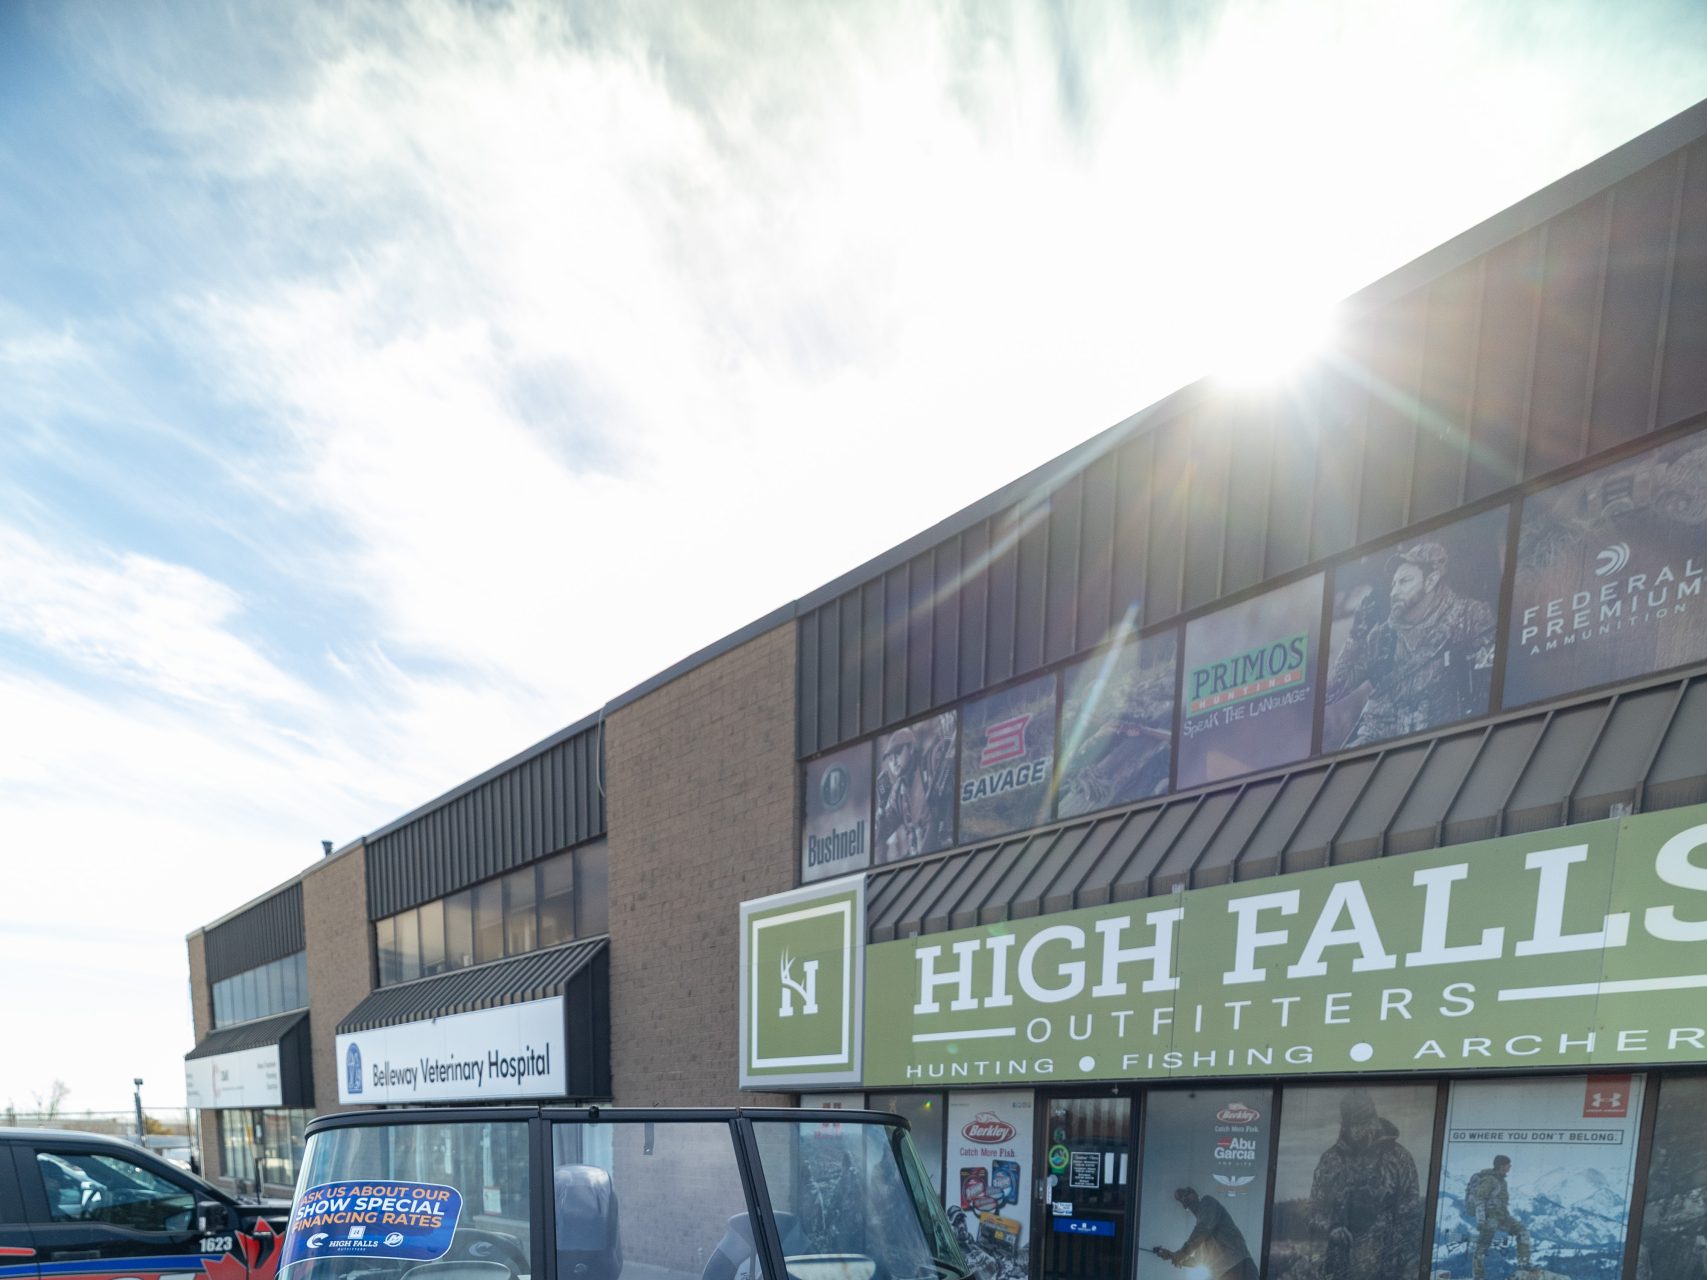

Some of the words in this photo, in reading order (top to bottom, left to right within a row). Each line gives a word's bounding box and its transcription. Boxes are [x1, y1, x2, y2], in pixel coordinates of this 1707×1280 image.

[1523, 559, 1703, 626] FEDERAL
[1521, 577, 1702, 645] PREMIUM
[1530, 603, 1687, 656] AMMUNITION
[1191, 637, 1304, 700] PRIMOS
[1200, 673, 1292, 709] HUNTING
[1222, 705, 1246, 725] THE
[961, 757, 1053, 803] SAVAGE
[808, 820, 865, 868] Bushnell
[914, 907, 1185, 1015] HIGH
[1222, 823, 1707, 985] FALLS
[1026, 982, 1477, 1043] OUTFITTERS
[373, 1063, 418, 1091] Belleway
[420, 1053, 484, 1088] Veterinary
[488, 1042, 550, 1085] Hospital
[906, 1058, 1054, 1078] HUNTING
[1122, 1045, 1314, 1070] FISHING
[1413, 1027, 1706, 1060] ARCHER
[968, 1124, 1011, 1141] Berkley
[1229, 1138, 1256, 1149] Abu
[1452, 1131, 1466, 1140] GO
[1469, 1131, 1504, 1140] WHERE
[1508, 1132, 1528, 1140] YOU
[1531, 1132, 1564, 1141] DON'T
[1568, 1132, 1618, 1142] BELONG.
[960, 1147, 979, 1157] Catch
[981, 1148, 997, 1158] More
[1214, 1147, 1255, 1160] Garcia
[296, 1198, 351, 1221] SHOW
[354, 1197, 445, 1217] SPECIAL
[302, 1189, 324, 1204] ASK
[327, 1186, 346, 1199] US
[349, 1186, 409, 1198] ABOUT
[412, 1188, 450, 1202] OUR
[291, 1211, 378, 1234] FINANCING
[382, 1213, 442, 1229] RATES
[200, 1236, 233, 1253] 1623
[353, 1240, 379, 1248] FALLS
